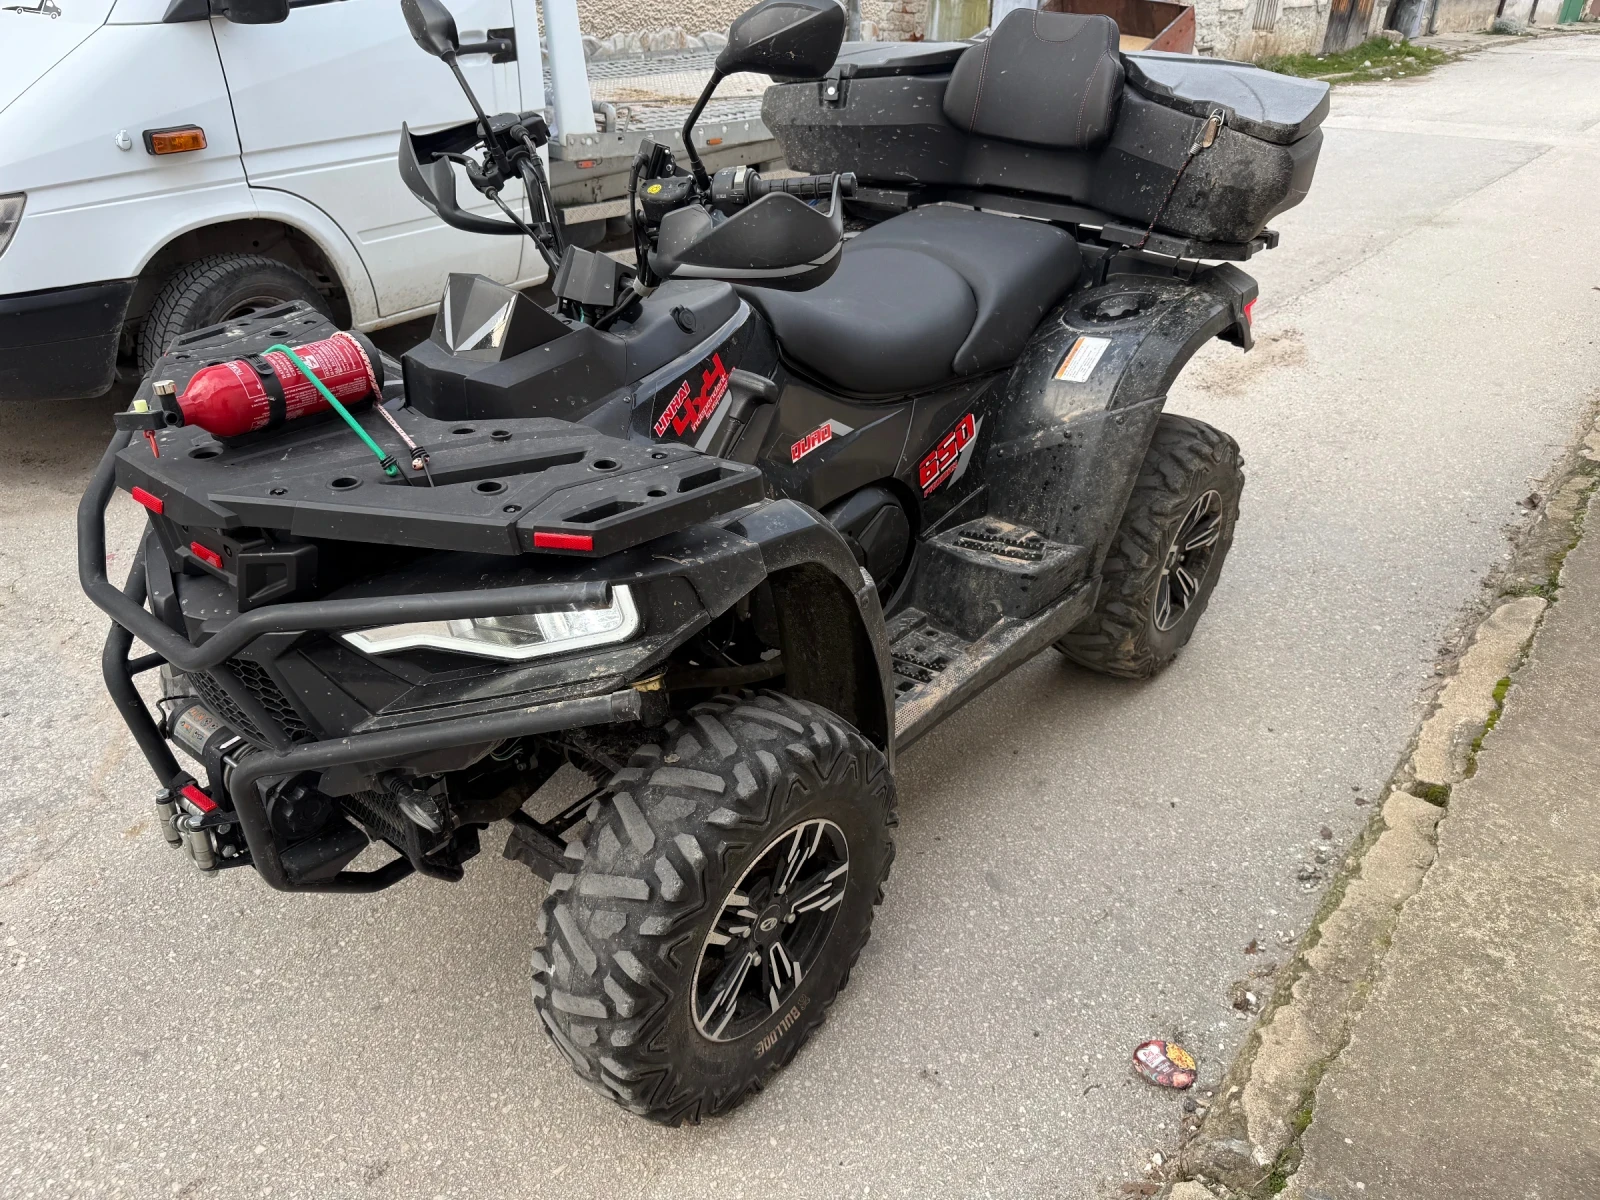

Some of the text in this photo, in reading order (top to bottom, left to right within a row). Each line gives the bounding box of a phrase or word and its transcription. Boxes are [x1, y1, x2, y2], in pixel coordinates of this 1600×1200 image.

[653, 379, 691, 437] LINHAI
[672, 353, 727, 436] 4x4
[791, 423, 832, 463] QUAD
[919, 413, 976, 489] 650
